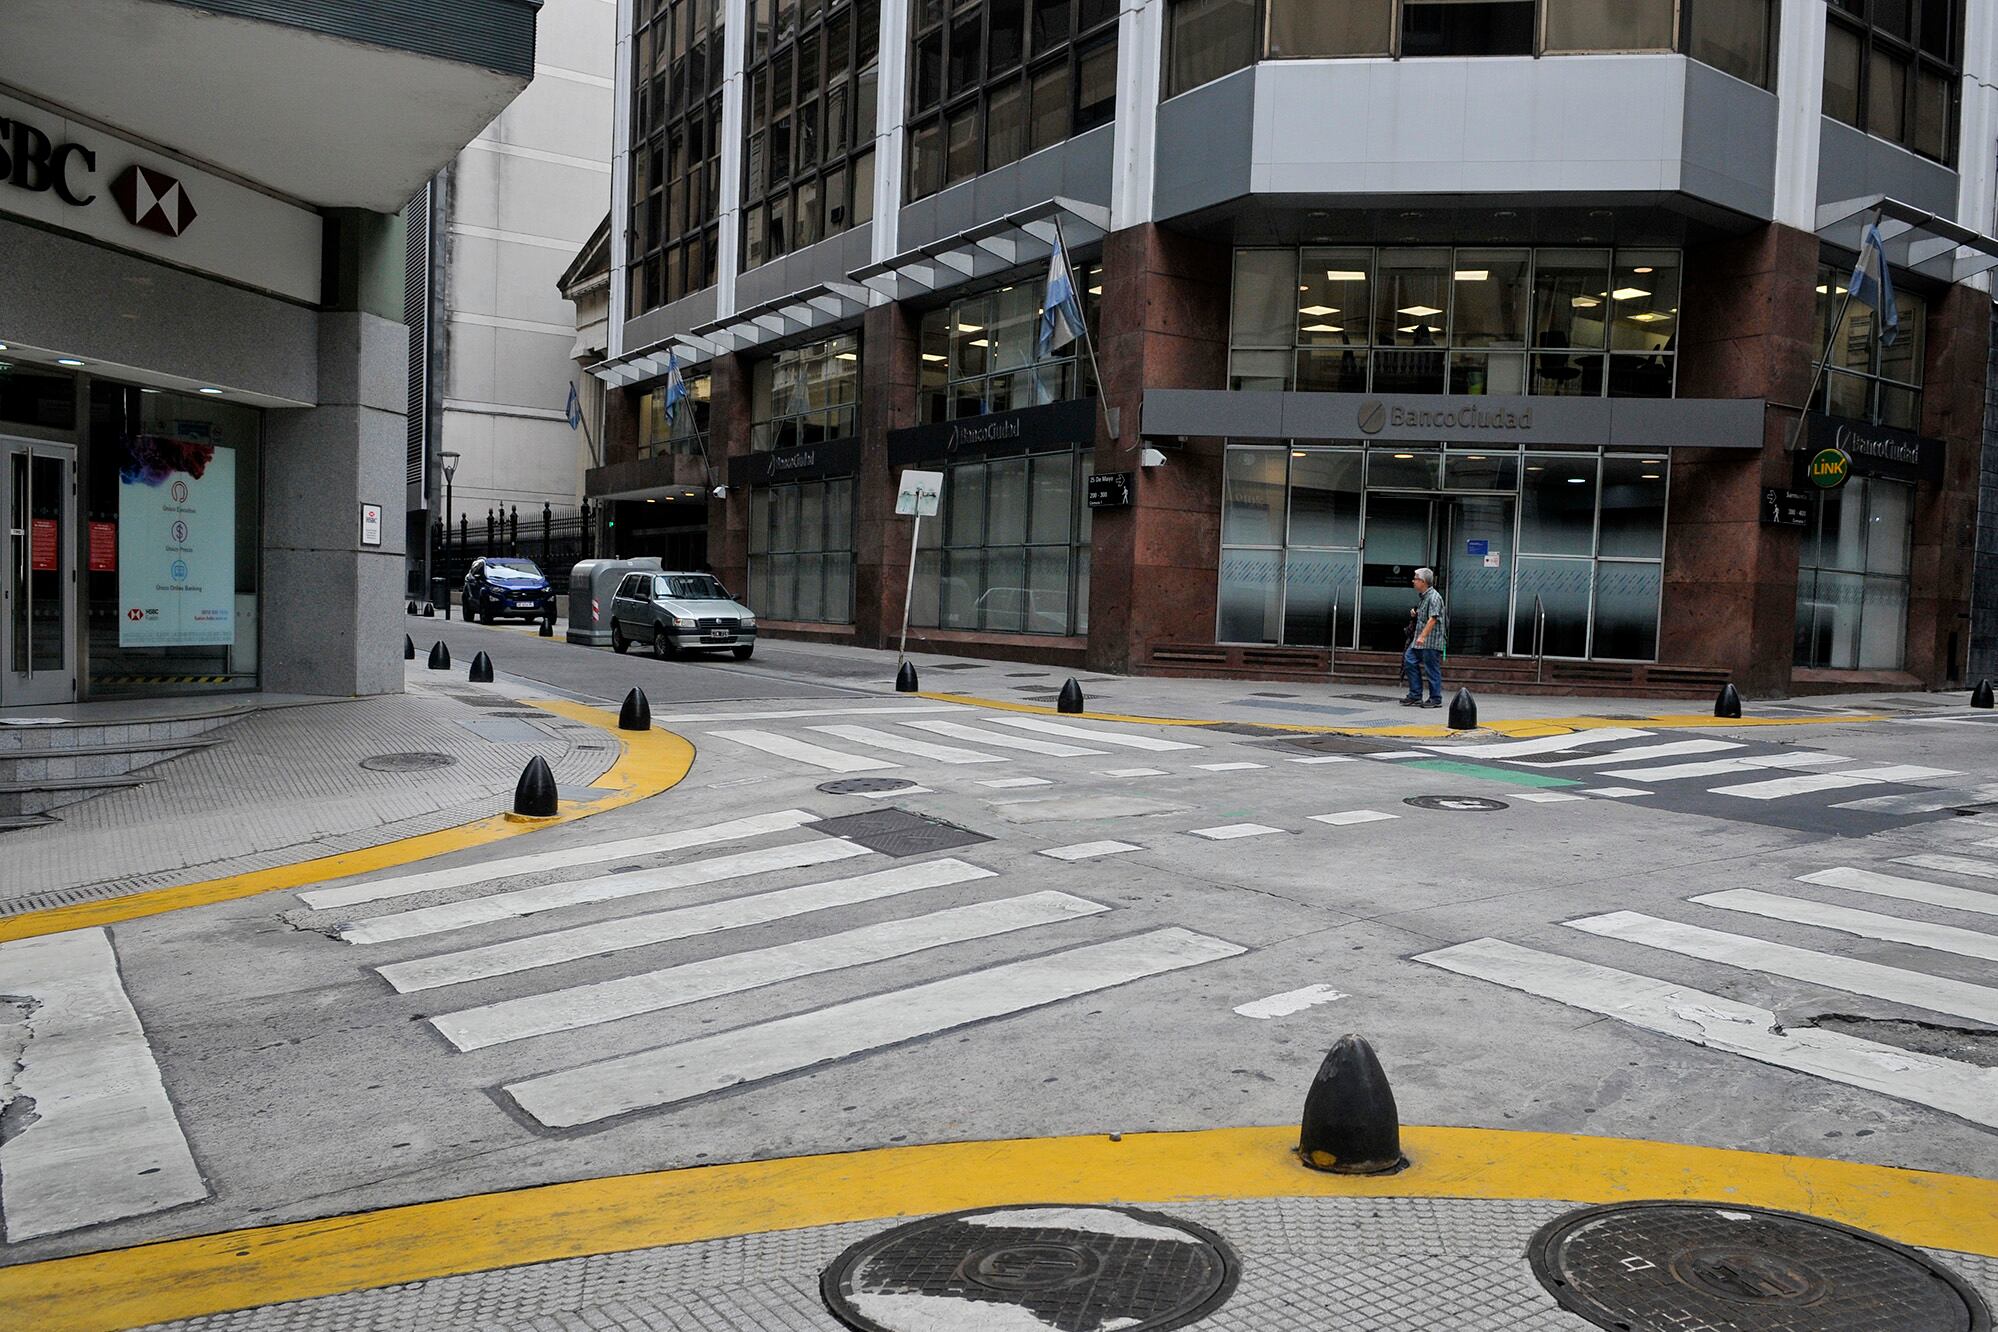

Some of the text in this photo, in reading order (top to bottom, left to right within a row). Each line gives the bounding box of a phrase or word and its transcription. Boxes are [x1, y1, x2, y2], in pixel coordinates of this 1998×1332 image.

[1391, 404, 1533, 429] BancoCiudad
[960, 417, 1020, 445] BancoCiudad
[1852, 432, 1919, 464] BancoCiudad
[1101, 475, 1114, 483] Mayo
